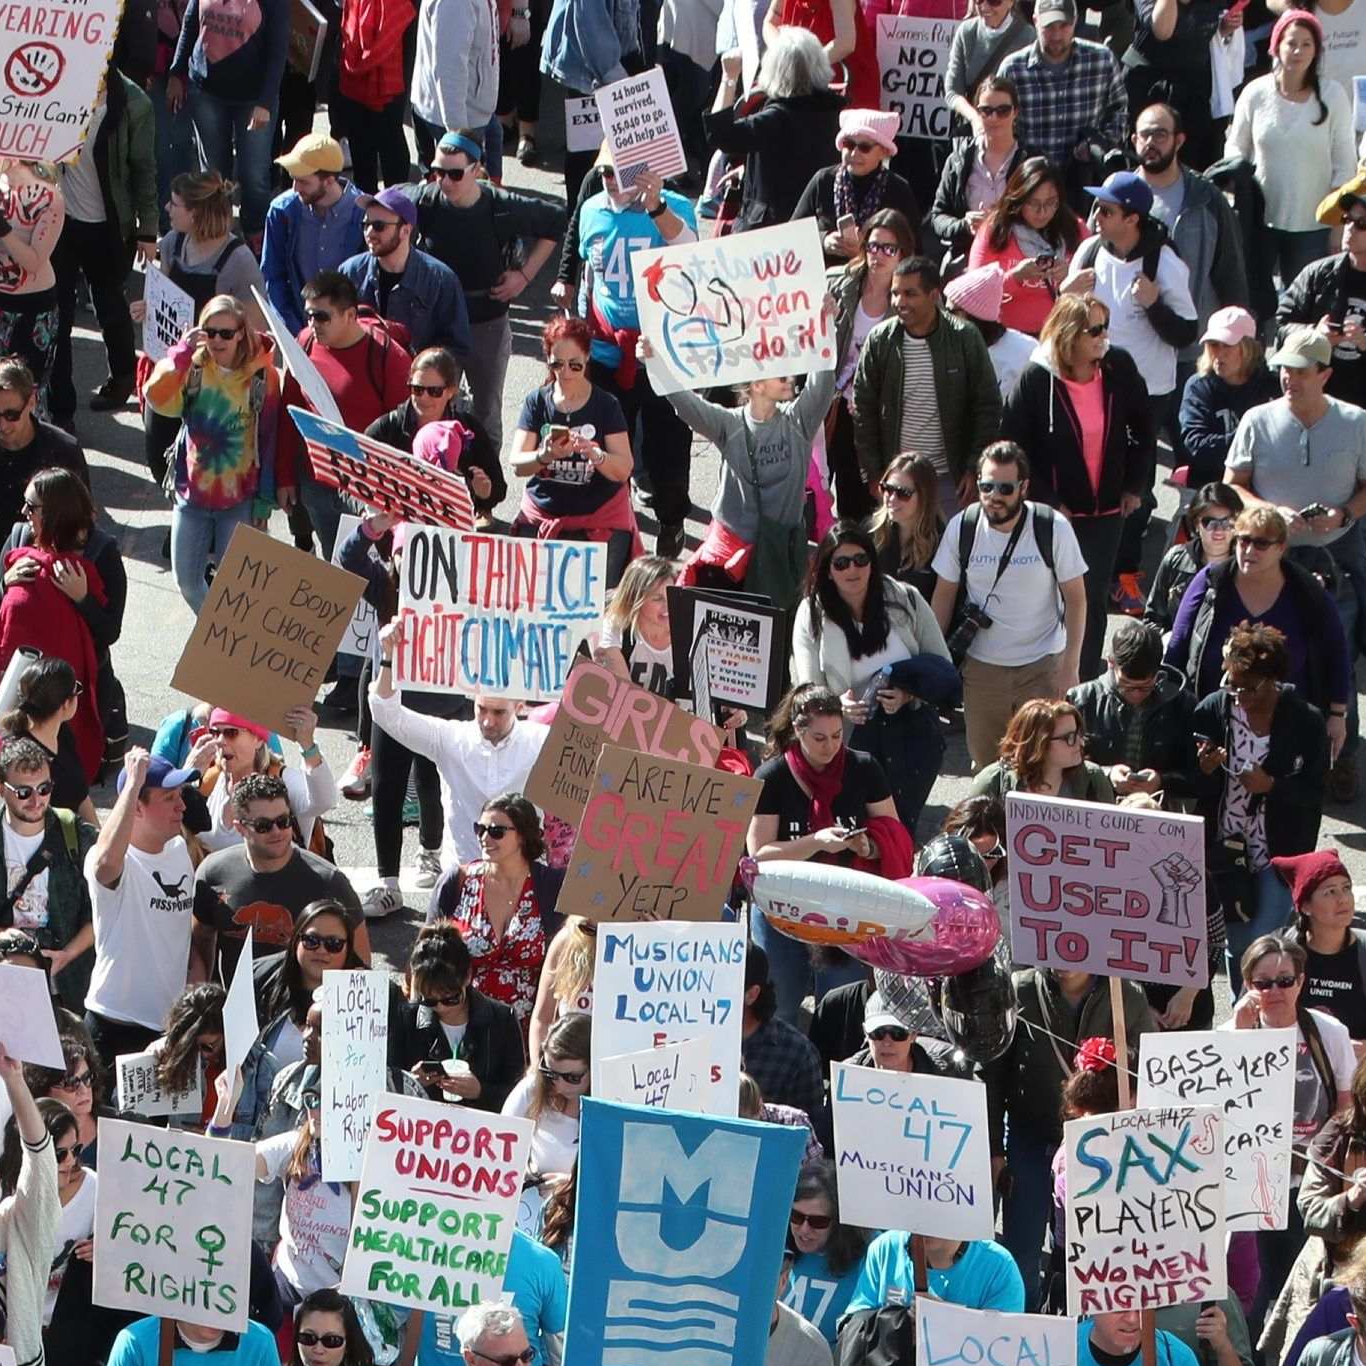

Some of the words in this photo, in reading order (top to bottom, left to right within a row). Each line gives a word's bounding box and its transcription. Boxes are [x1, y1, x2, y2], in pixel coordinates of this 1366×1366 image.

[898, 46, 937, 67] NO
[44, 102, 89, 126] Can't
[624, 80, 651, 101] hours
[754, 249, 802, 281] we
[758, 289, 810, 320] can
[237, 555, 276, 591] MY
[289, 578, 347, 625] BODY
[408, 531, 458, 604] ON
[461, 534, 538, 613] THIN
[540, 542, 599, 613] ICE
[395, 604, 464, 687] FIGHT
[460, 616, 569, 693] CLIMATE
[563, 660, 725, 768] GIRLS
[619, 758, 675, 800] ARE
[680, 772, 723, 815] WE
[582, 794, 745, 894] GREAT
[1011, 823, 1132, 871] GET
[1016, 872, 1151, 919] USED
[603, 934, 744, 965] MUSICIANS
[337, 985, 381, 1014] LOCAL
[633, 966, 714, 994] UNION
[120, 1133, 233, 1186] LOCAL
[375, 1109, 519, 1162] SUPPORT
[1073, 1121, 1203, 1200] SAX
[141, 1179, 196, 1206] 47
[837, 1148, 957, 1186] MUSICIANS
[360, 1188, 504, 1241] SUPPORT
[1074, 1185, 1220, 1236] PLAYERS
[352, 1225, 507, 1278] HEALTHCARE
[122, 1262, 237, 1316] RIGHTS
